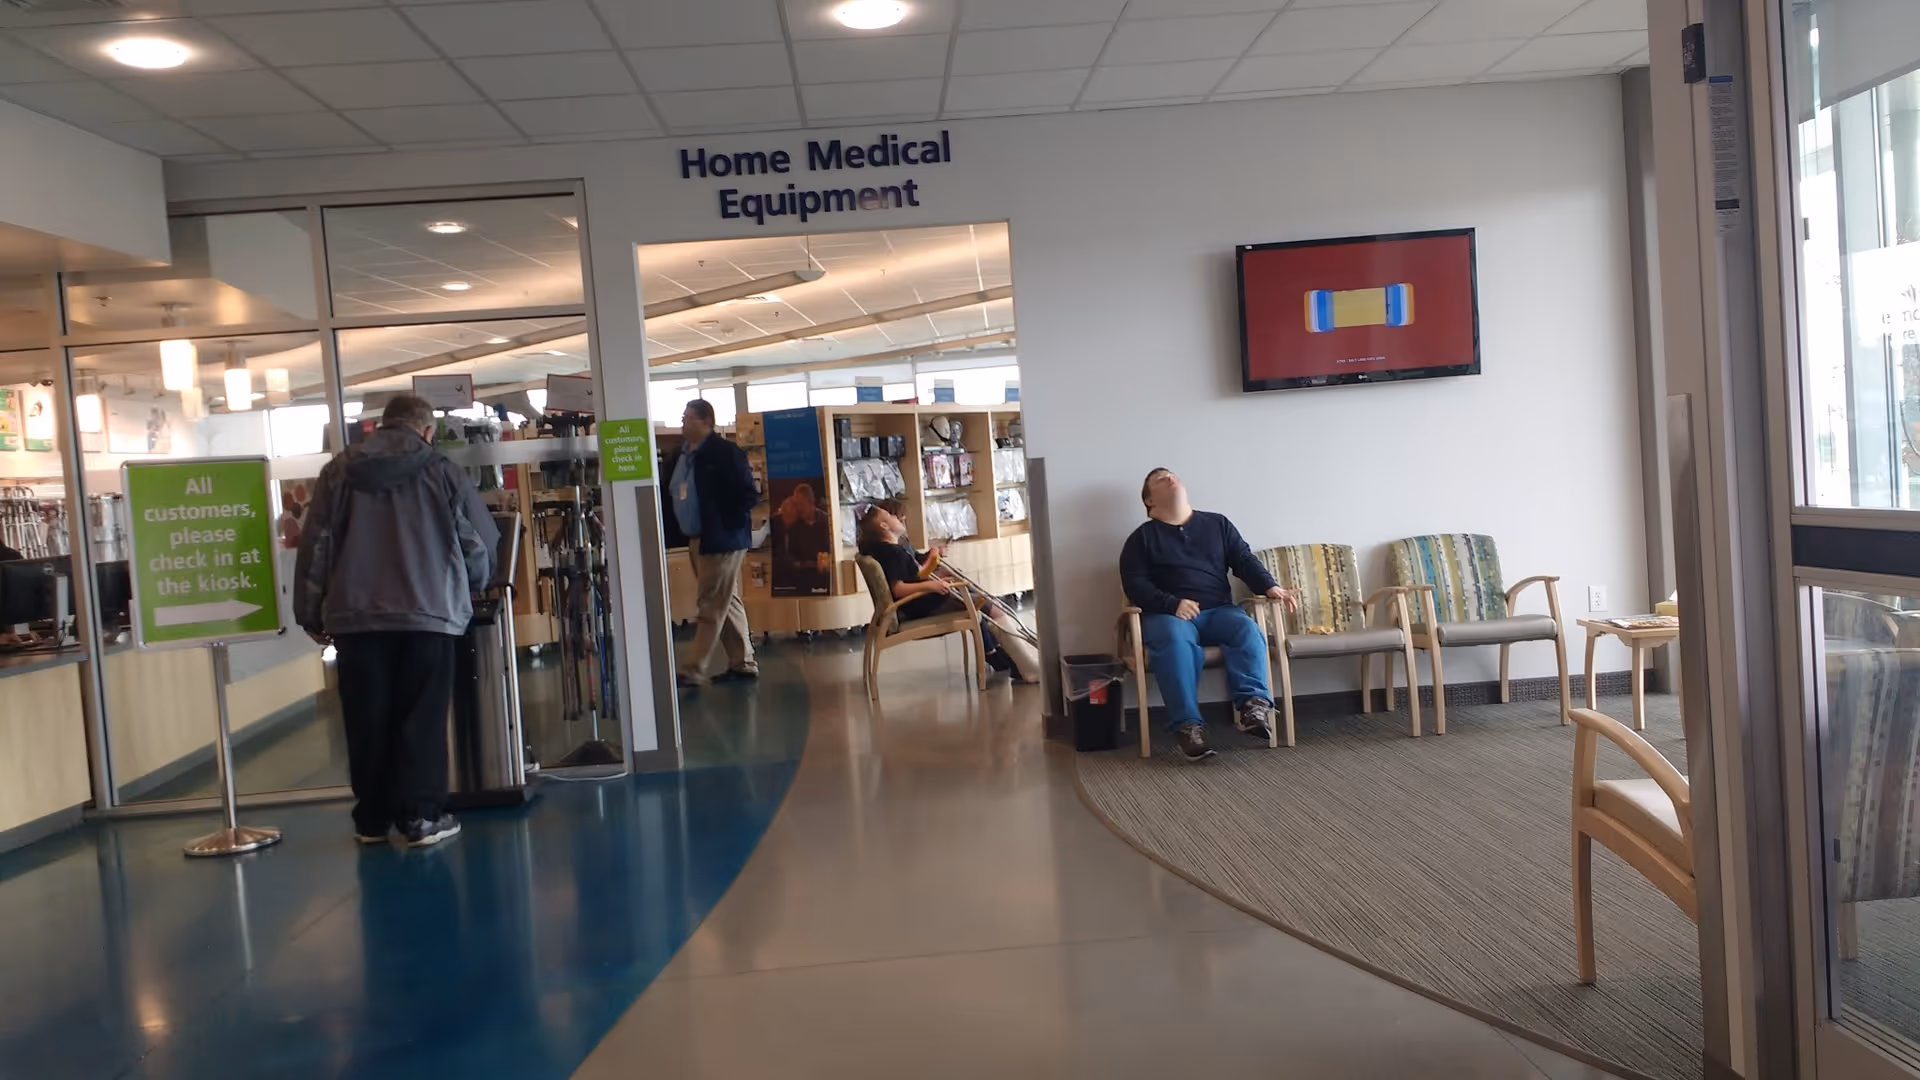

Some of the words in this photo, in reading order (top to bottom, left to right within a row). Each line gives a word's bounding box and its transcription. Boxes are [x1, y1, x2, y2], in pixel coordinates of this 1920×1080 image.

[680, 148, 790, 179] Home
[807, 130, 951, 171] Medical
[719, 179, 920, 225] Equipment
[619, 425, 630, 433] All
[612, 454, 633, 463] check
[614, 445, 639, 455] please
[185, 475, 212, 495] All
[144, 503, 256, 522] customers,
[170, 527, 237, 549] please
[150, 550, 208, 572] check
[214, 549, 233, 567] in
[240, 548, 260, 564] at
[157, 577, 192, 595] the
[199, 571, 257, 593] kiosk.
